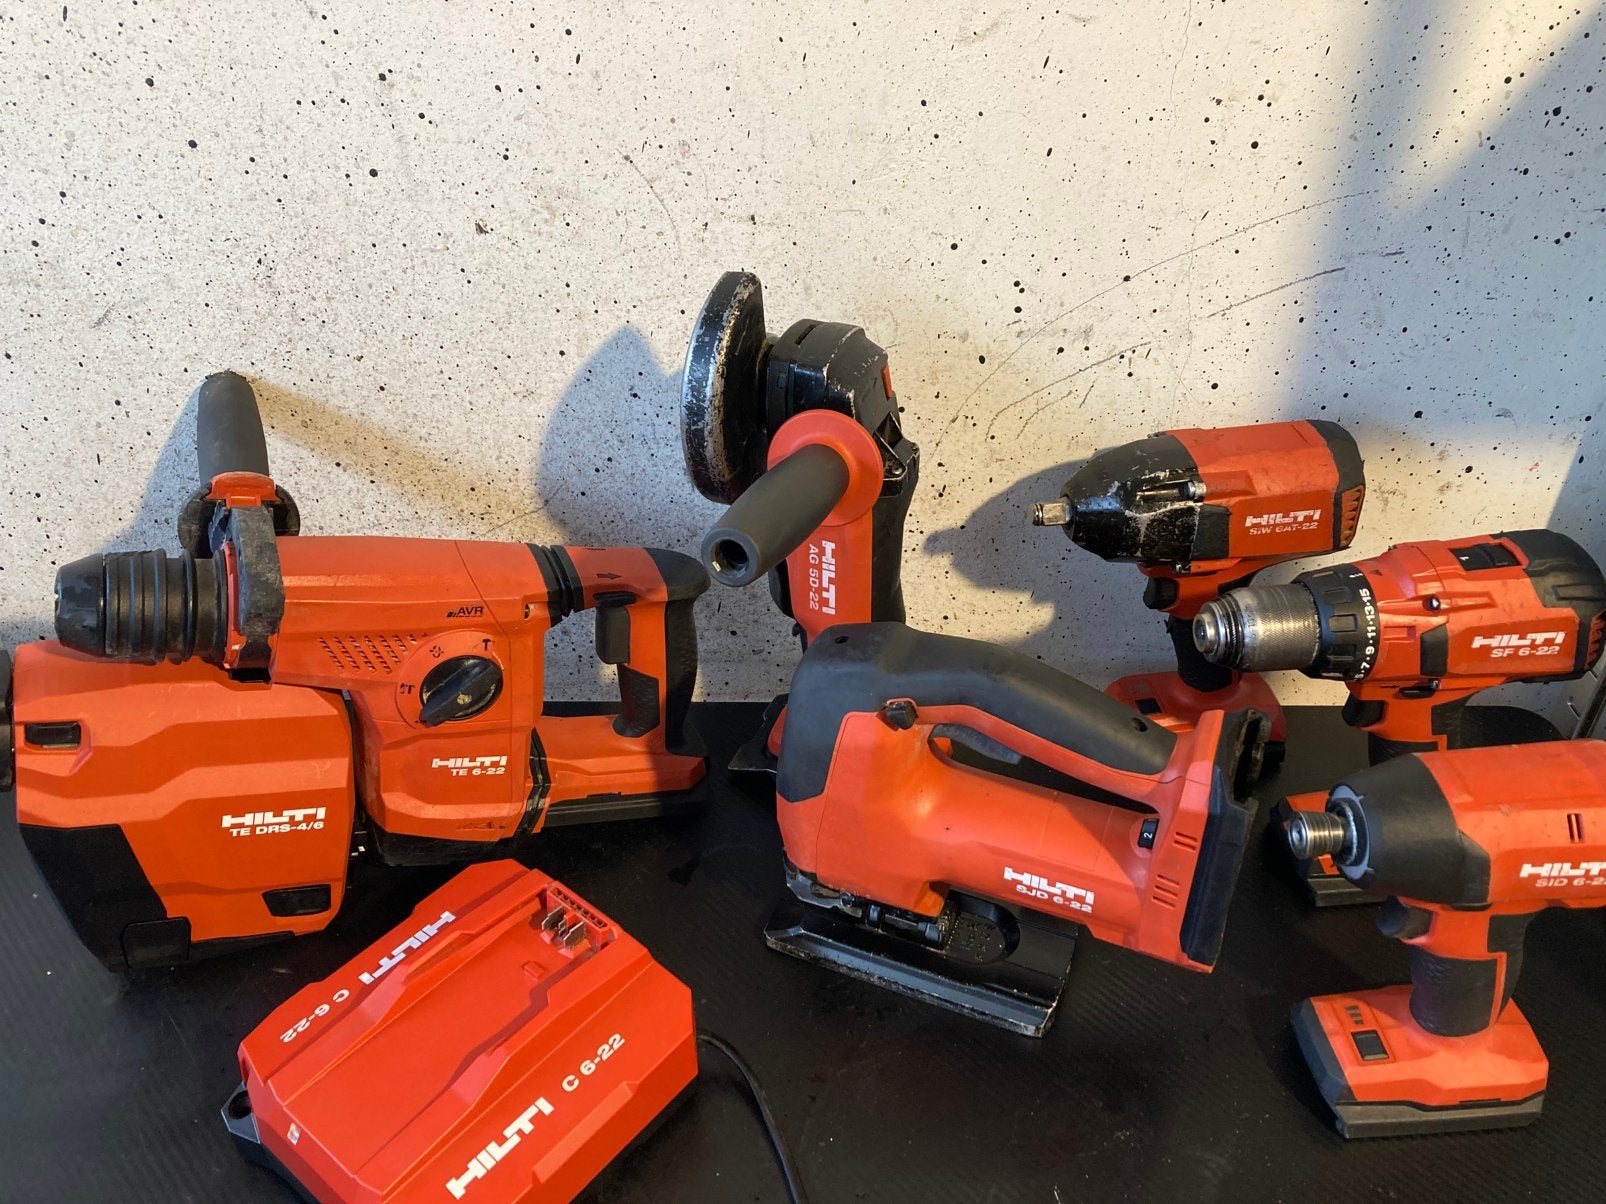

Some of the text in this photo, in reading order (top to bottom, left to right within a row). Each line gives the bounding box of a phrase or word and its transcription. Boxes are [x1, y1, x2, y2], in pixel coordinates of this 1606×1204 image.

[1245, 508, 1322, 527] HILTI
[1249, 526, 1273, 535] SIW
[809, 543, 819, 611] AG 5D-22
[821, 540, 836, 615] HILTI
[457, 606, 484, 616] AVR
[1471, 631, 1566, 648] HILTI
[1490, 646, 1560, 658] SF 6-22
[431, 755, 508, 768] HILTI
[450, 767, 506, 777] TE 6-22
[221, 807, 326, 828] HILTI
[229, 821, 325, 837] TE DRS-4/6
[1519, 862, 1606, 878] HILT
[1003, 866, 1095, 905] HILTI
[1535, 877, 1606, 887] SID 6-2
[1052, 895, 1093, 913] 6-22
[279, 910, 456, 1043] HILTI C 6-22
[445, 1033, 626, 1200] HILTI C 6-22
